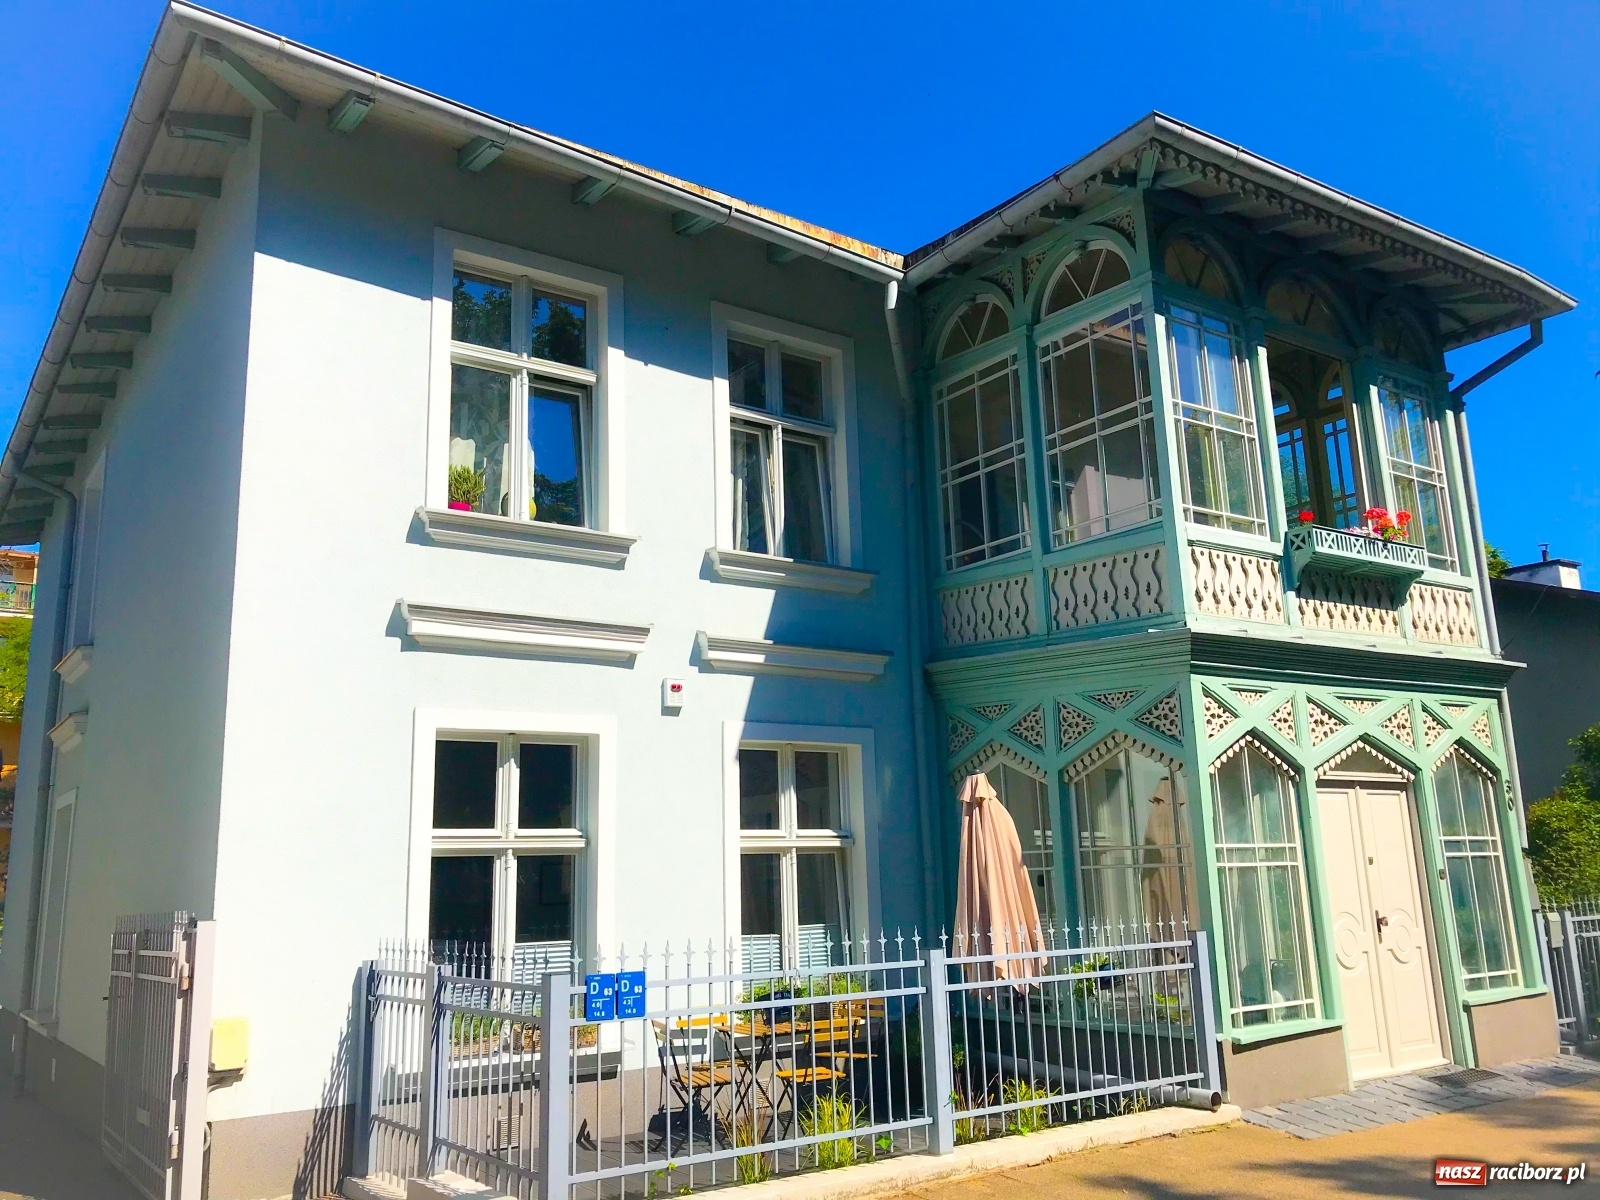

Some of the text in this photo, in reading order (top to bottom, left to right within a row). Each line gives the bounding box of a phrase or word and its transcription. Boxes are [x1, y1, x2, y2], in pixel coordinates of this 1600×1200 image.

[590, 982, 613, 996] D 63
[621, 980, 643, 994] D 63
